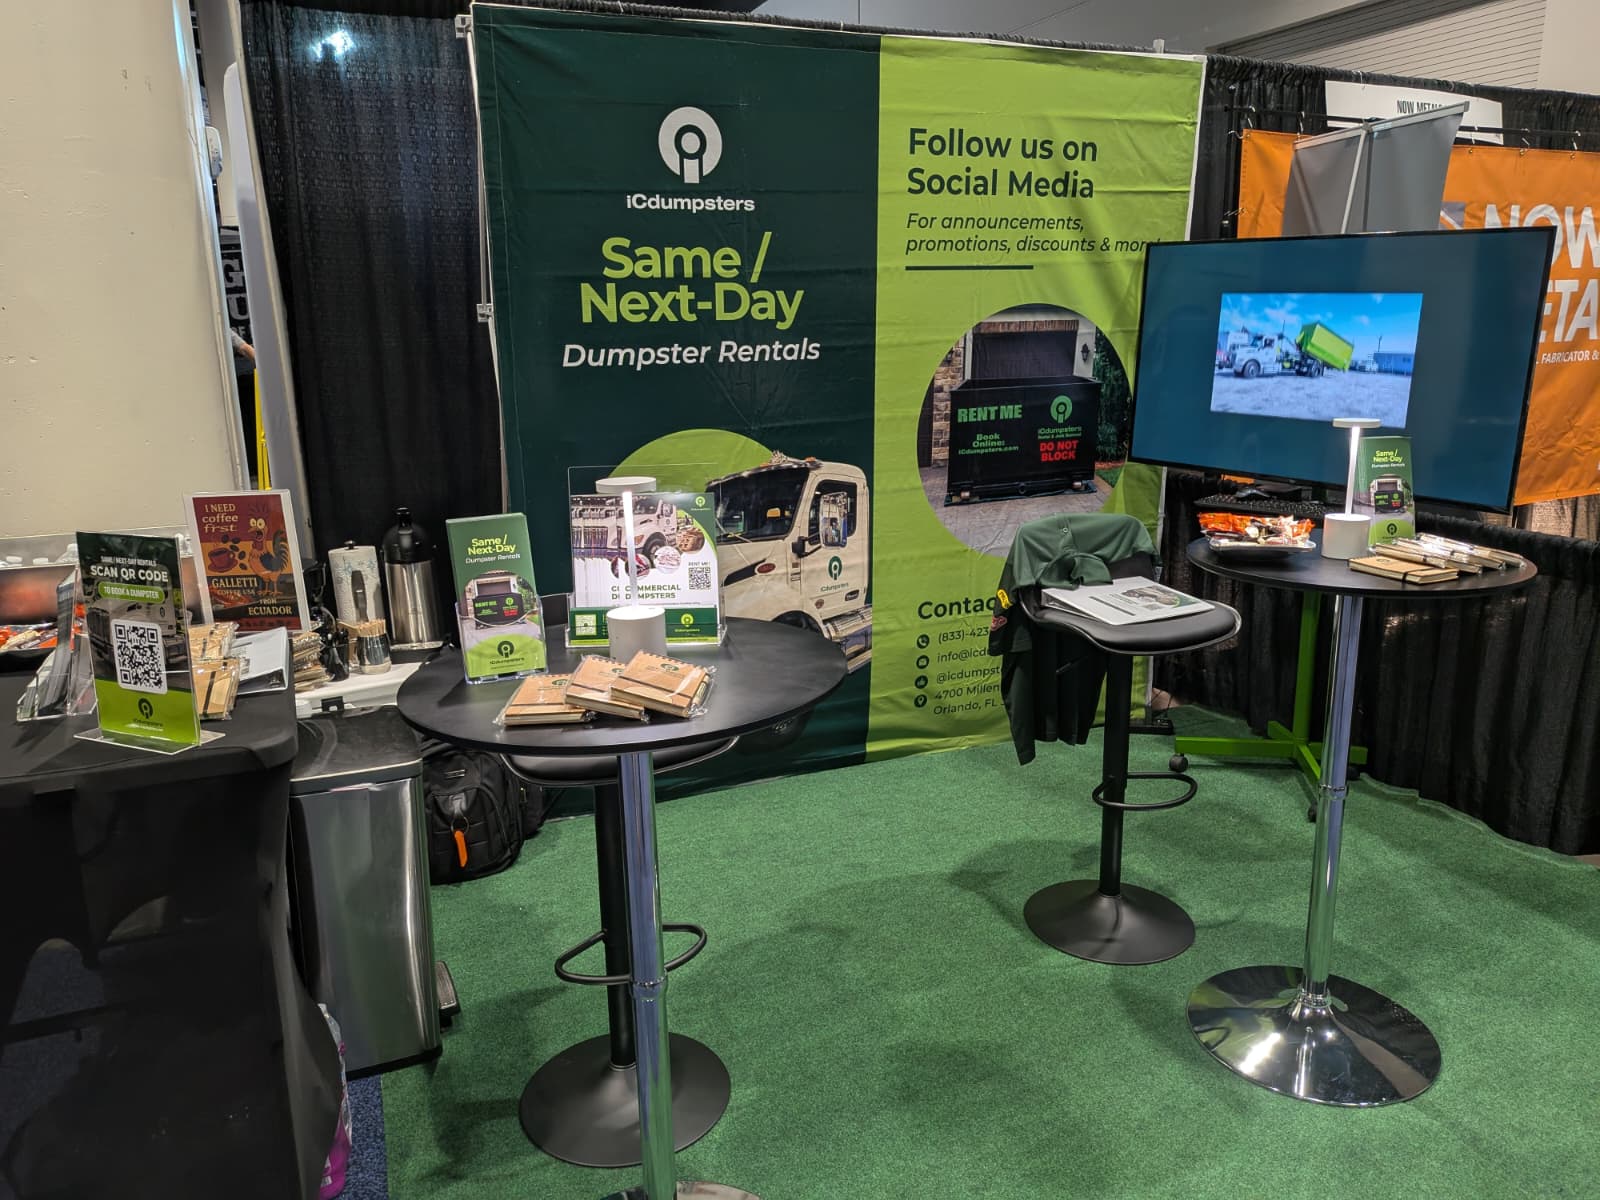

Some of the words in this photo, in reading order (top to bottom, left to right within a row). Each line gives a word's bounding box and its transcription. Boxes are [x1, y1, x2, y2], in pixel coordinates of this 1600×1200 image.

[1397, 100, 1414, 114] NOW
[909, 128, 1012, 158] Follow
[1021, 138, 1053, 159] us
[1062, 140, 1098, 161] on
[907, 167, 998, 196] Social
[1008, 170, 1094, 198] Media
[626, 193, 755, 213] iCdumpsters
[906, 213, 937, 229] For
[941, 215, 1085, 232] announcements,
[905, 236, 1012, 255] promotions,
[1016, 238, 1096, 252] discounts
[1100, 239, 1111, 252] &
[601, 237, 742, 278] Same
[750, 231, 772, 283] /
[580, 282, 804, 330] Next-Day
[562, 343, 711, 371] Dumpster
[718, 338, 820, 363] Rentals
[1541, 351, 1590, 364] FABRICATOR
[957, 406, 998, 423] RENT
[1000, 405, 1023, 420] ME
[976, 433, 1000, 441] Book
[1040, 441, 1054, 451] DO
[1057, 440, 1079, 450] NOT
[1041, 451, 1076, 461] BLOCK
[205, 504, 208, 513] I
[210, 503, 236, 513] NEED
[202, 513, 238, 524] coffee
[468, 544, 516, 556] Next-Day
[471, 538, 501, 548] Same
[465, 556, 496, 564] Dumpster
[497, 553, 521, 561] Rentals
[90, 565, 118, 578] SCAN
[121, 568, 136, 580] QR
[138, 570, 169, 582] CODE
[212, 577, 258, 588] GALLETTI
[625, 584, 681, 592] CMMERCIAL
[625, 592, 676, 600] DMPSTERS
[248, 606, 292, 615] ECUADOR
[918, 597, 997, 619] Contac
[934, 687, 963, 700] 4700
[966, 684, 1000, 696] Millen
[933, 701, 981, 714] Orlando,
[985, 699, 999, 707] FL
